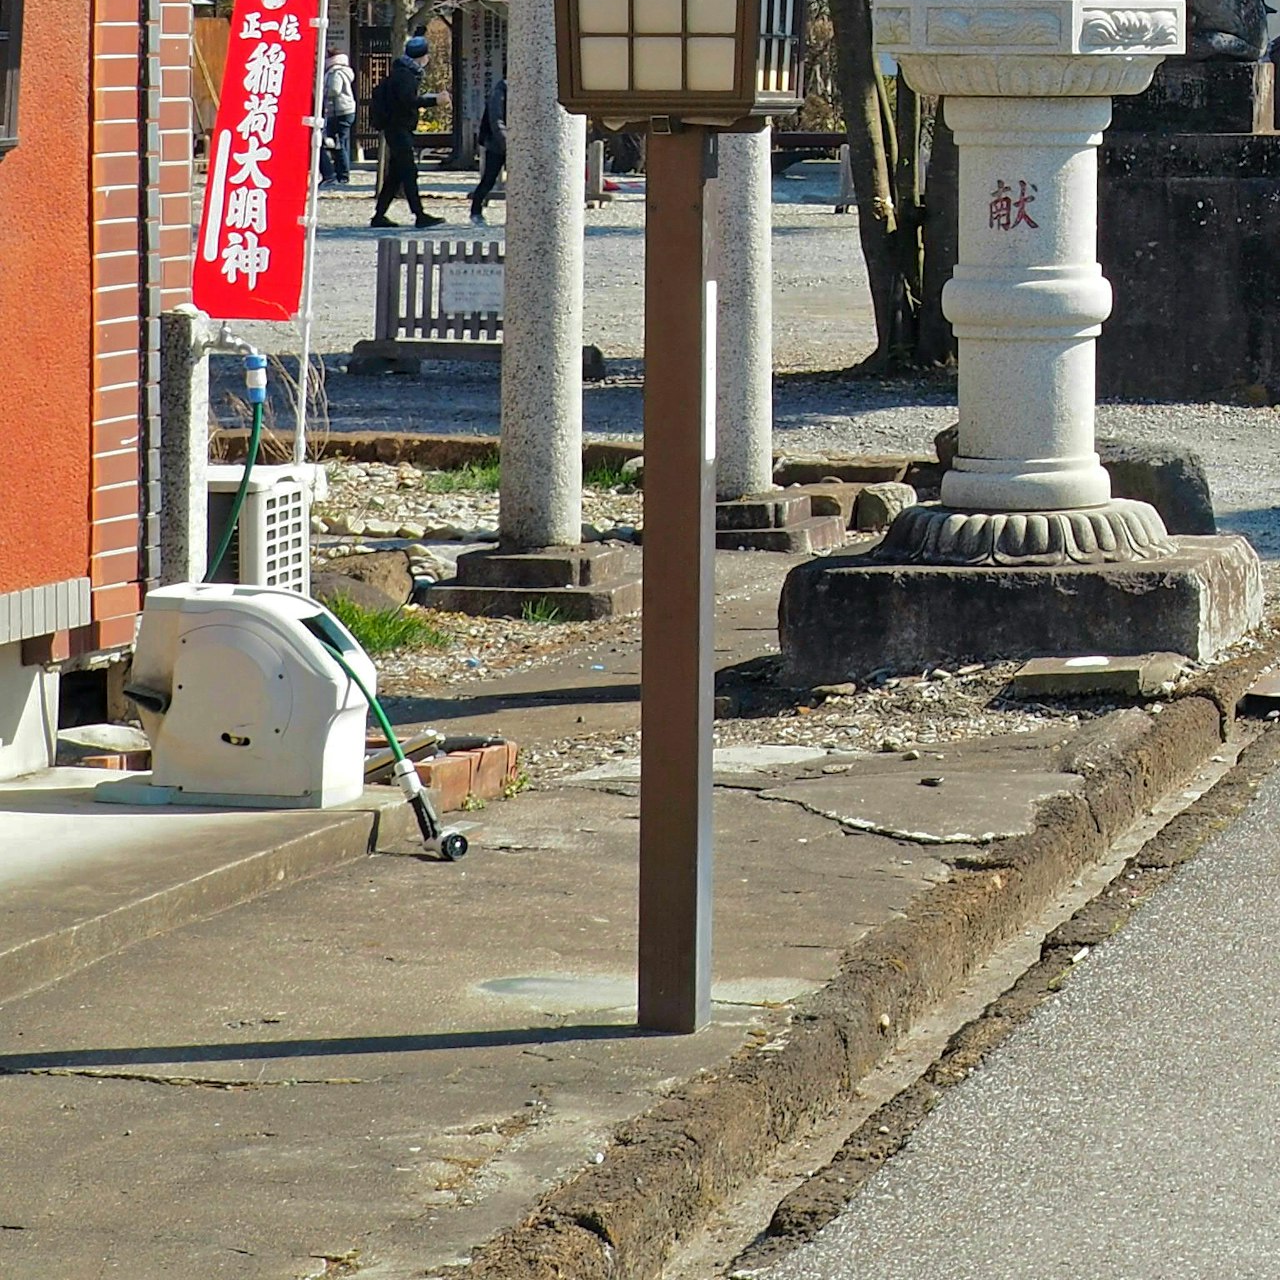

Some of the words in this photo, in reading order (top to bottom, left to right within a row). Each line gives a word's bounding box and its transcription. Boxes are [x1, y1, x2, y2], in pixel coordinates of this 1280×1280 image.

[238, 11, 302, 42] 正一位
[221, 41, 287, 291] 稲荷大明神
[988, 179, 1040, 232] 献
